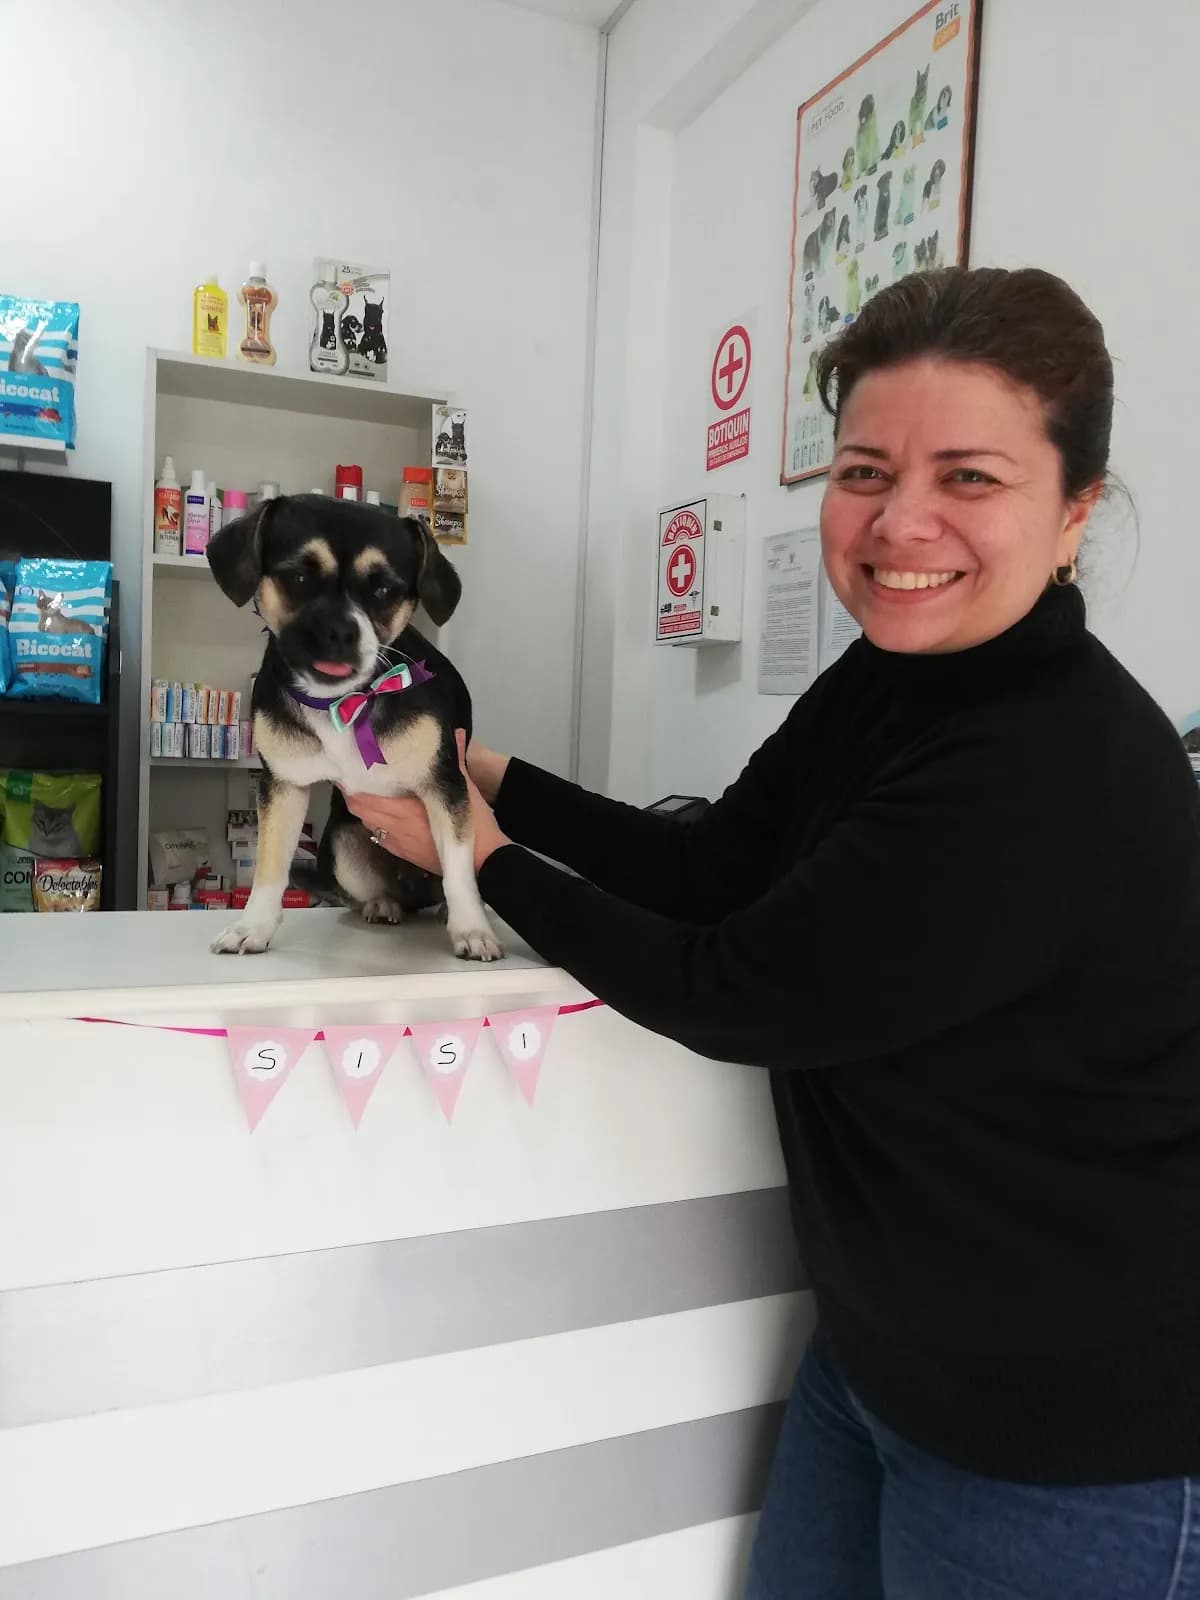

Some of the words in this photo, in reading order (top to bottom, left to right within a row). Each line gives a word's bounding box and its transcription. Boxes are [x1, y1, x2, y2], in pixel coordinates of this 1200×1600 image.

[825, 101, 845, 125] FOOD
[0, 378, 60, 402] icocat
[708, 412, 749, 449] BOTIQUIN
[667, 515, 698, 540] BOTIQUIN
[16, 638, 93, 658] Ricocat
[39, 874, 99, 893] Delectables
